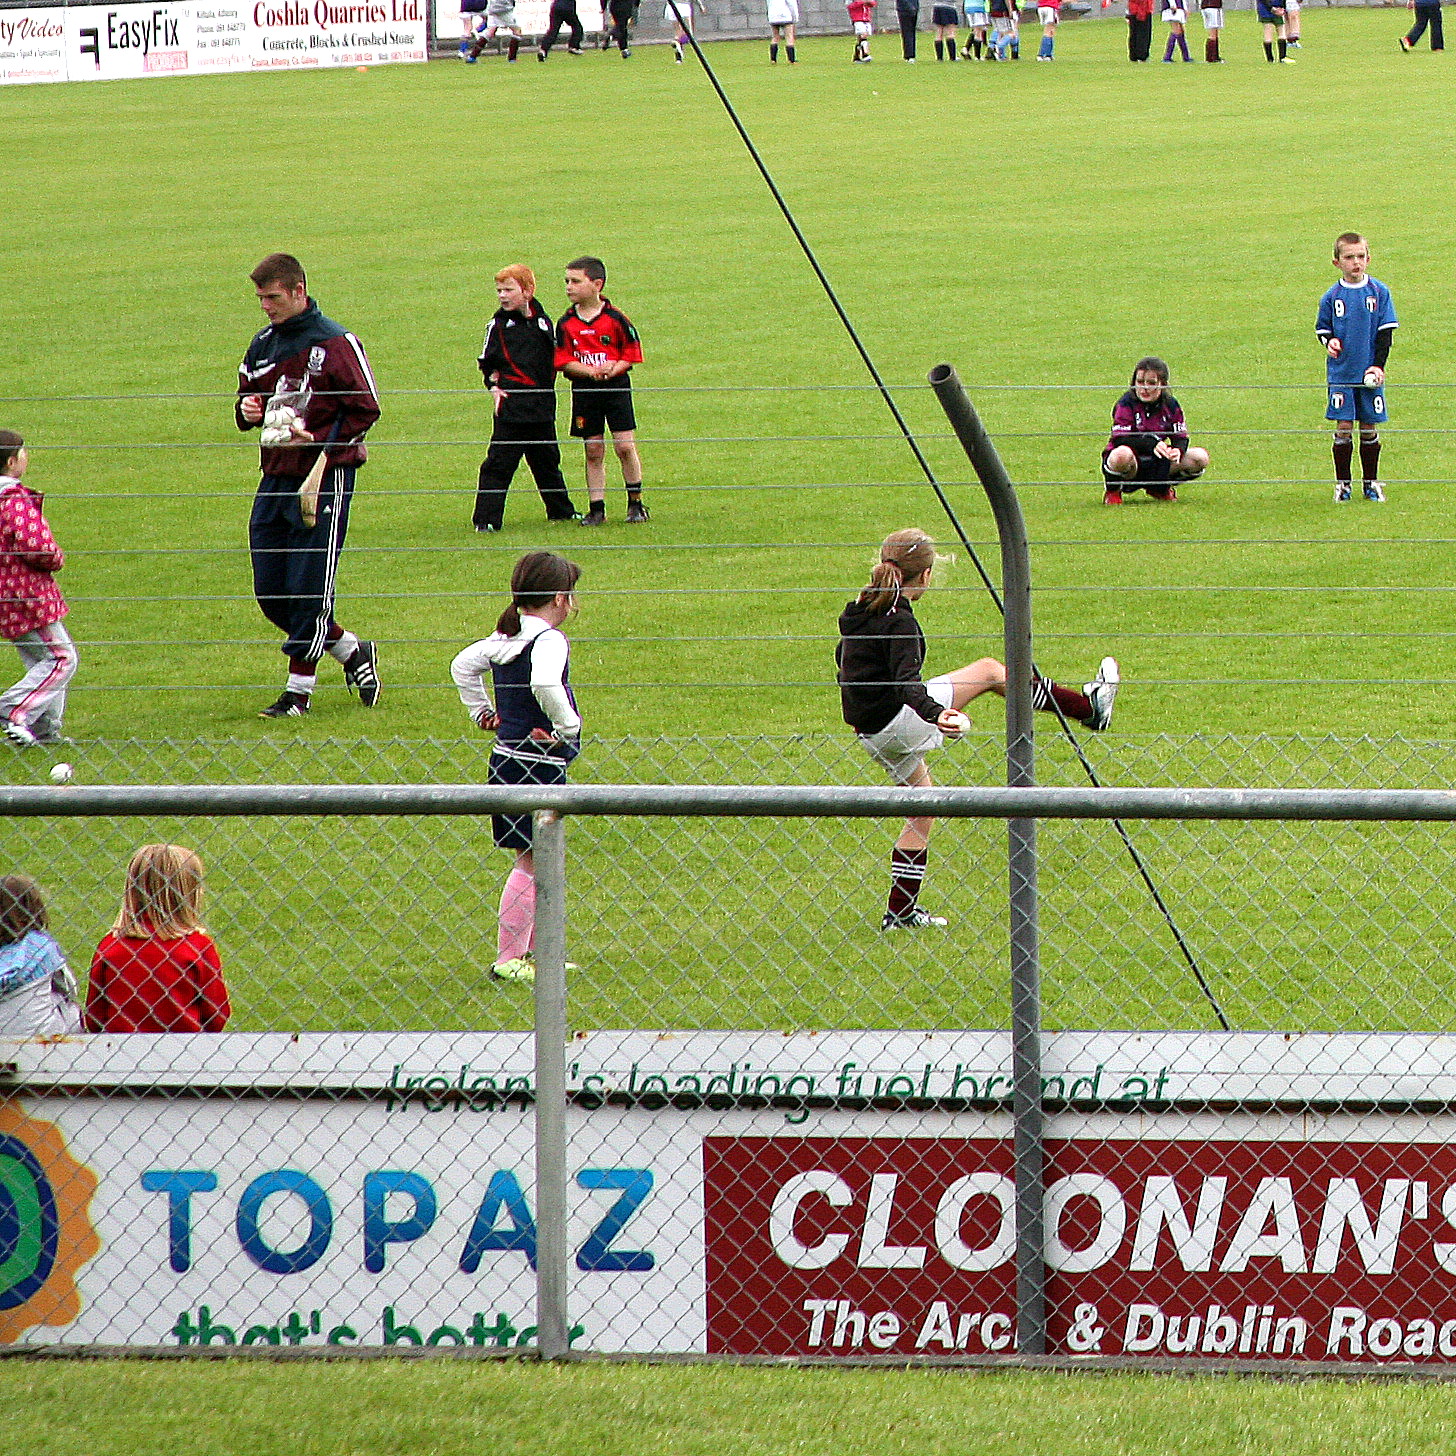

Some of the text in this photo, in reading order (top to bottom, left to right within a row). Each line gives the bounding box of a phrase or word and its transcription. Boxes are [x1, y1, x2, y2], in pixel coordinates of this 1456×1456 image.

[17, 17, 63, 41] Video
[253, 0, 309, 27] Coshla
[108, 9, 179, 55] EasyFix
[1334, 299, 1345, 318] 9
[1374, 395, 1384, 414] 9
[384, 1063, 607, 1114] Irelan's
[624, 1063, 816, 1124] leading
[836, 1062, 933, 1102] fuel
[1122, 1066, 1170, 1101] at
[140, 1167, 656, 1275] TOPAZ
[802, 1298, 902, 1350] The
[916, 1299, 1018, 1351] Arc
[1066, 1302, 1104, 1353] &
[1123, 1302, 1308, 1355] Dublin
